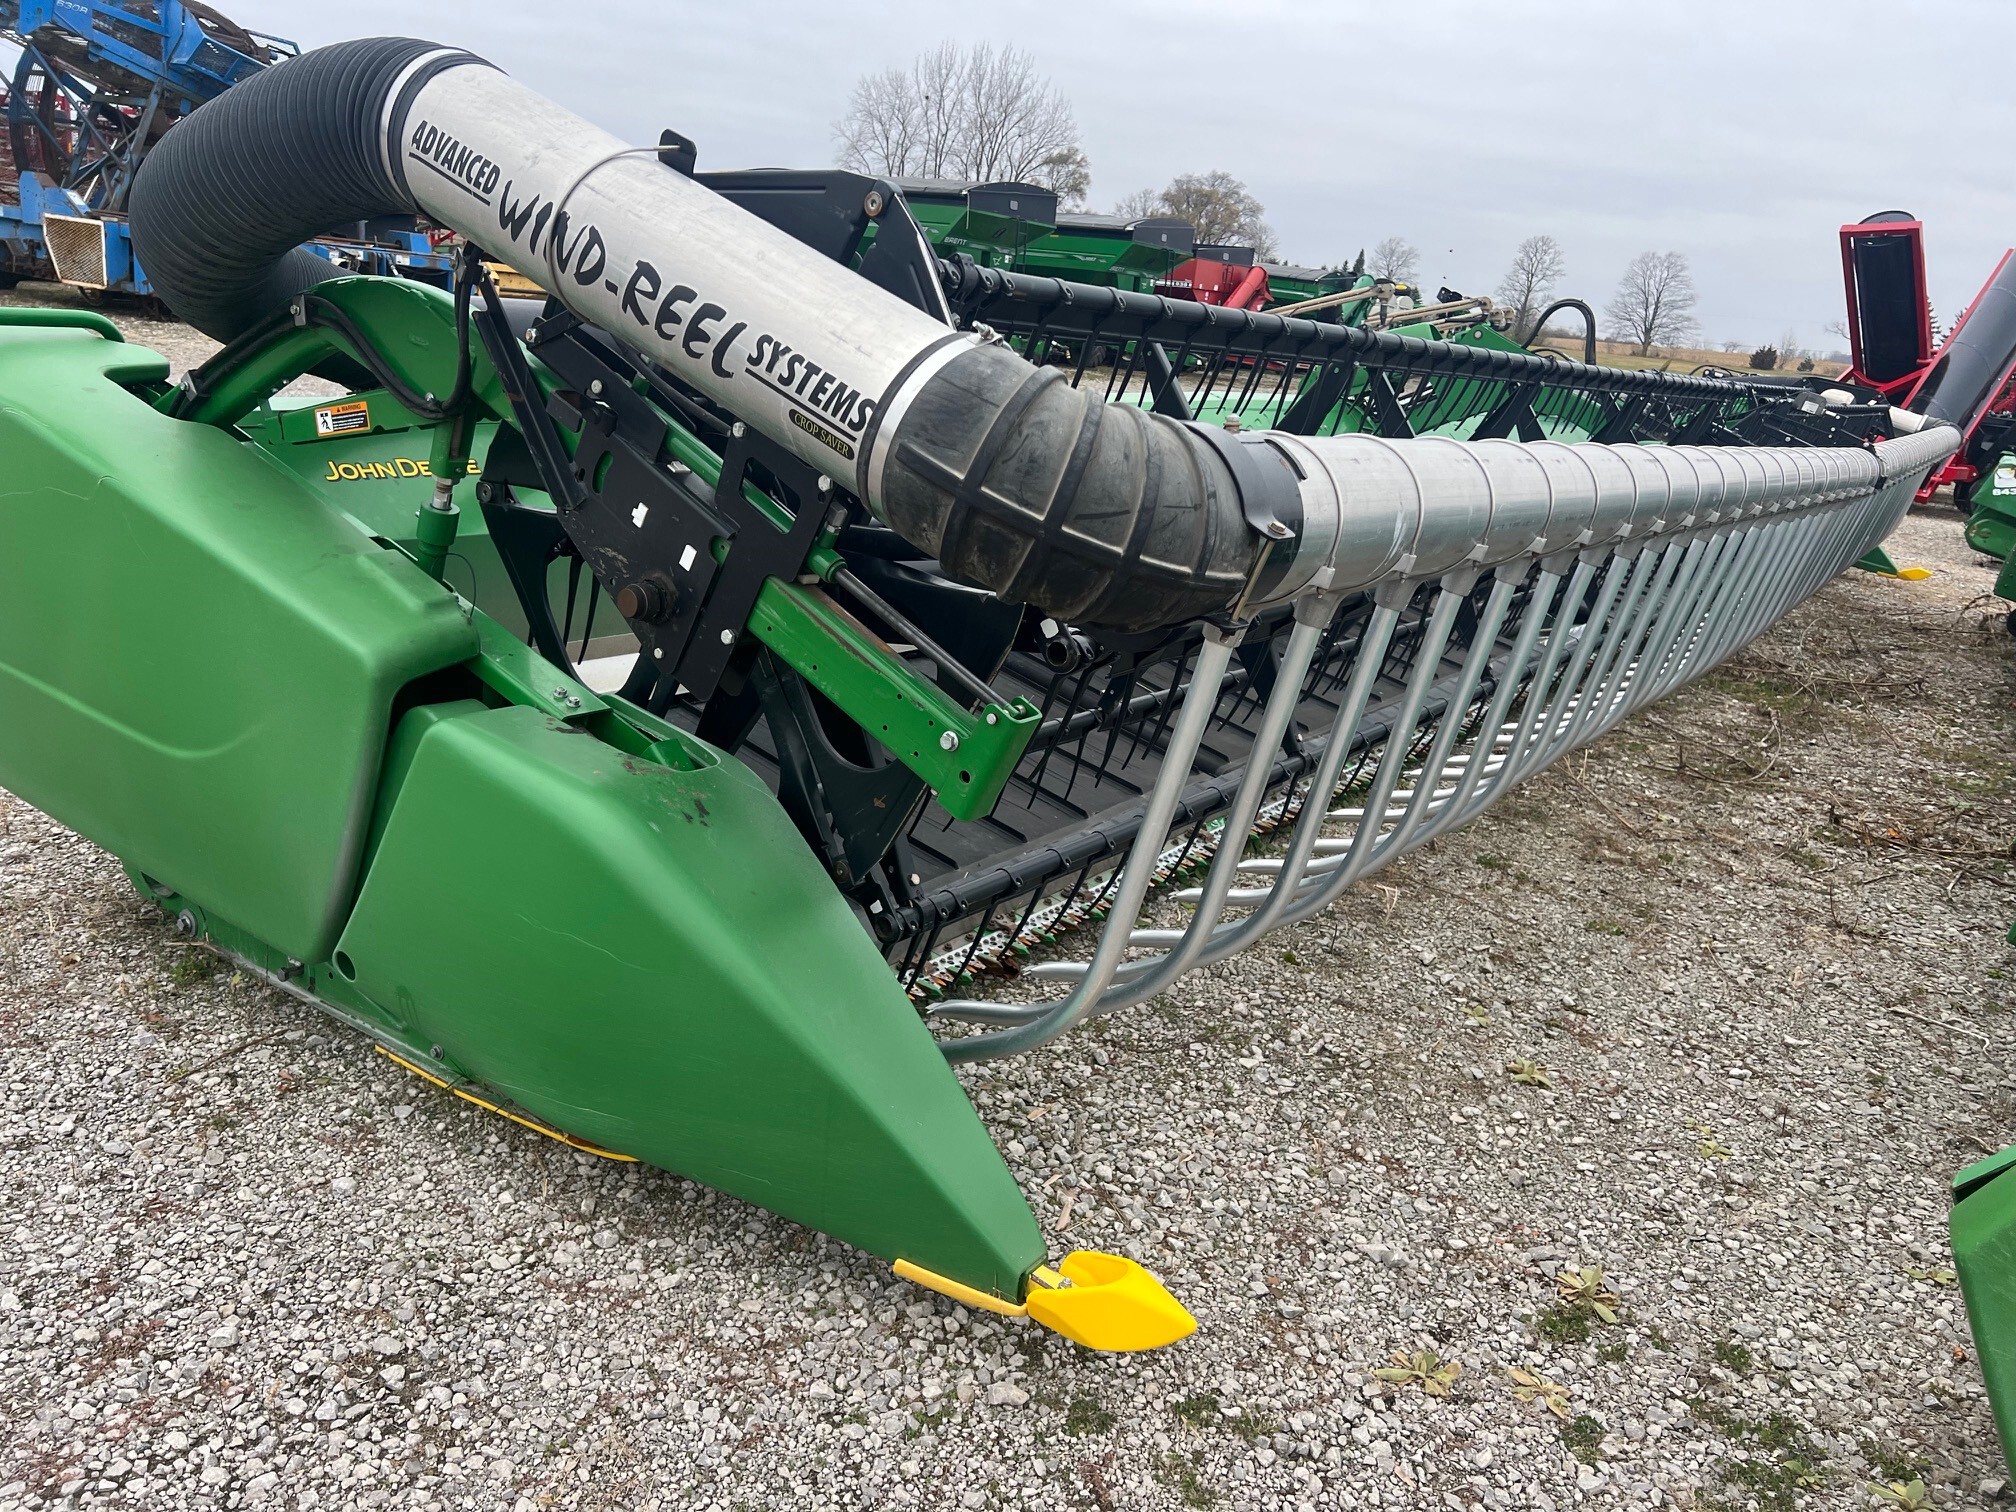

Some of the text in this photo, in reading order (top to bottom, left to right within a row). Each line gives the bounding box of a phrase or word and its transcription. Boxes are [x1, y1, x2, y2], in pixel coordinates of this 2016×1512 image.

[410, 119, 501, 195] ADVANCED
[943, 236, 968, 246] BRENT
[499, 180, 747, 379] WIND-REEL
[746, 334, 877, 432] SYSTEMS
[794, 413, 849, 457] CROP SAVER
[325, 458, 482, 481] JOHN DEE
